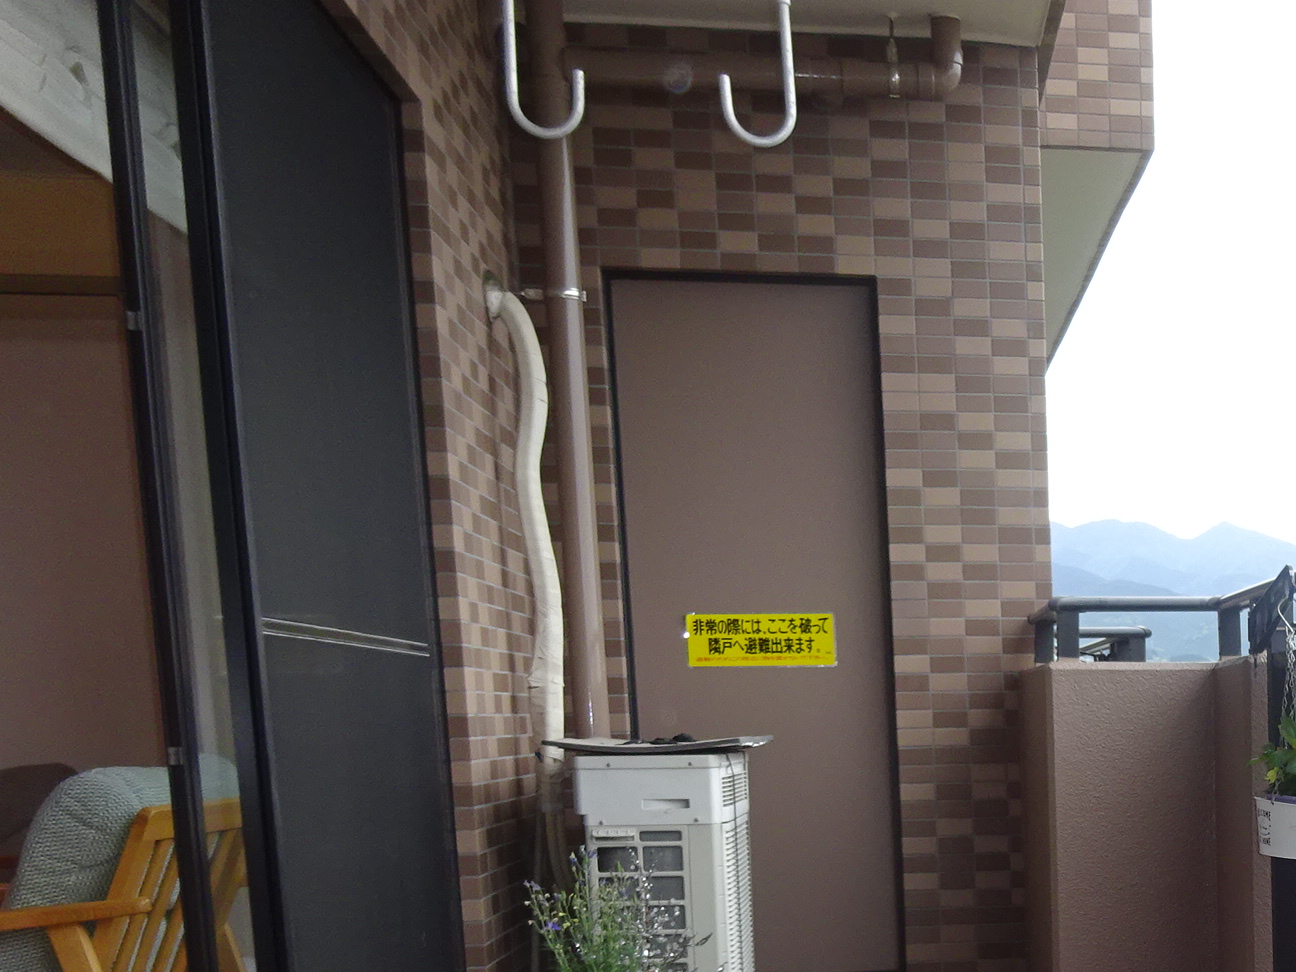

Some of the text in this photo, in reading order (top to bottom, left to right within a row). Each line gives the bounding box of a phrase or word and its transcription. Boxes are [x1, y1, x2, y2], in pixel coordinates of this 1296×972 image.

[693, 618, 829, 635] 非常の際には、ここを破って
